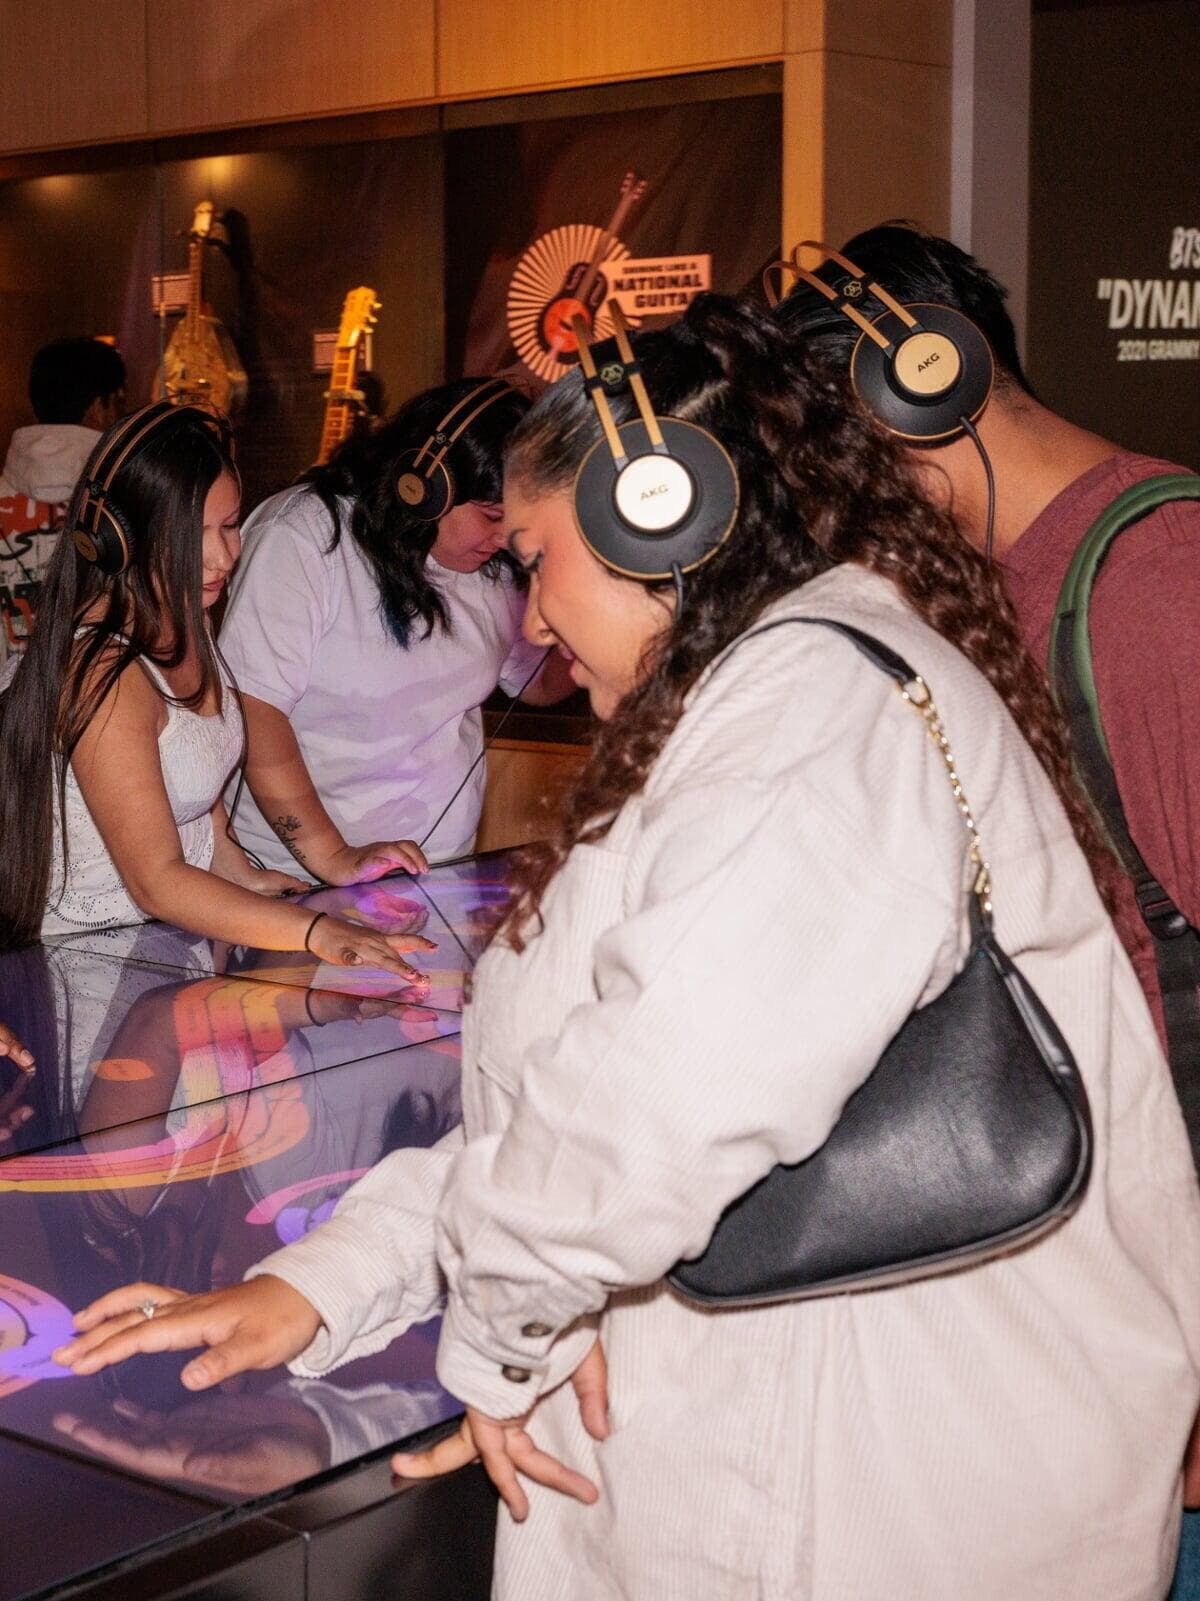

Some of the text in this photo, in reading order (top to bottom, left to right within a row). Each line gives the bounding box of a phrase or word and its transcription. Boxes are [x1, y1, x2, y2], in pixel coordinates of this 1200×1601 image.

[614, 273, 702, 292] NATIONAL
[917, 352, 940, 373] AKG
[640, 484, 669, 501] AKG
